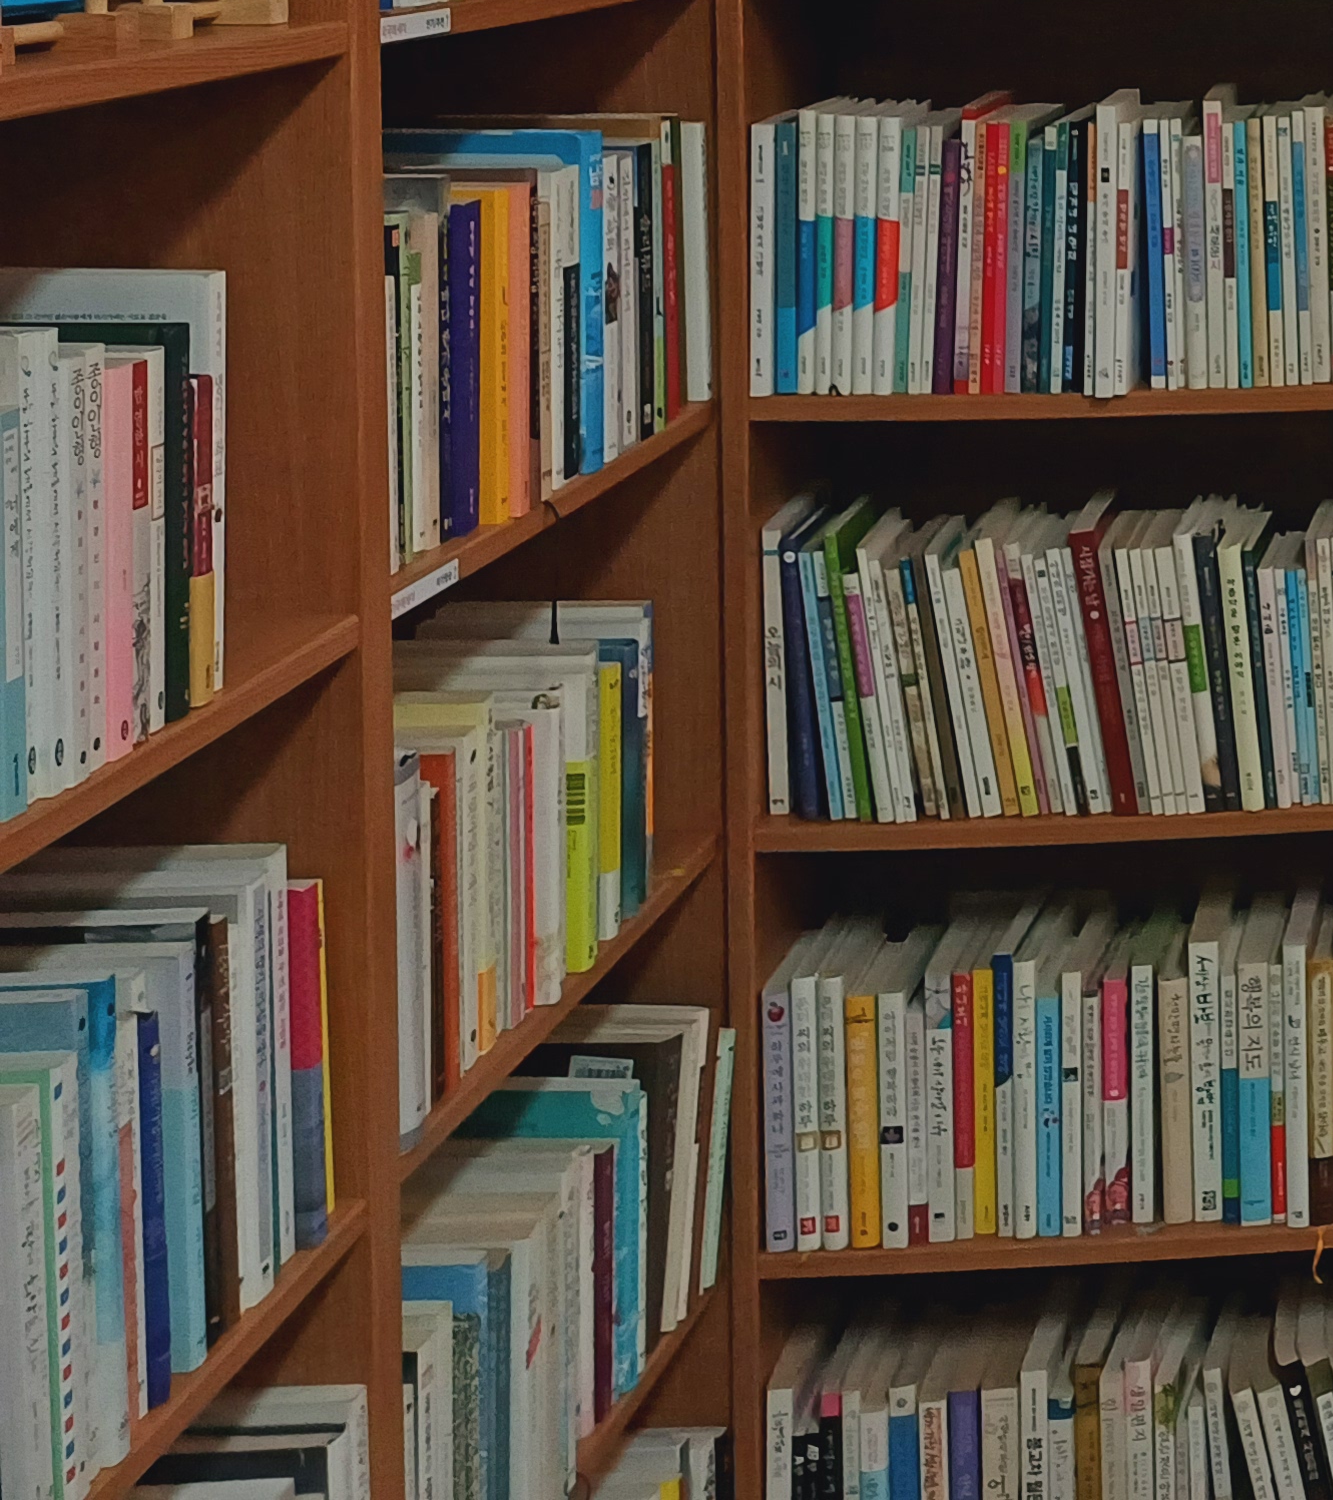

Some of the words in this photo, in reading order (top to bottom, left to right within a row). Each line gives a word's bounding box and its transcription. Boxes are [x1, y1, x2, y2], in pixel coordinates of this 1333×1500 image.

[1241, 977, 1263, 1029] 행복의
[1242, 1035, 1263, 1072] 지도
[1025, 1438, 1043, 1476] 봉고차
